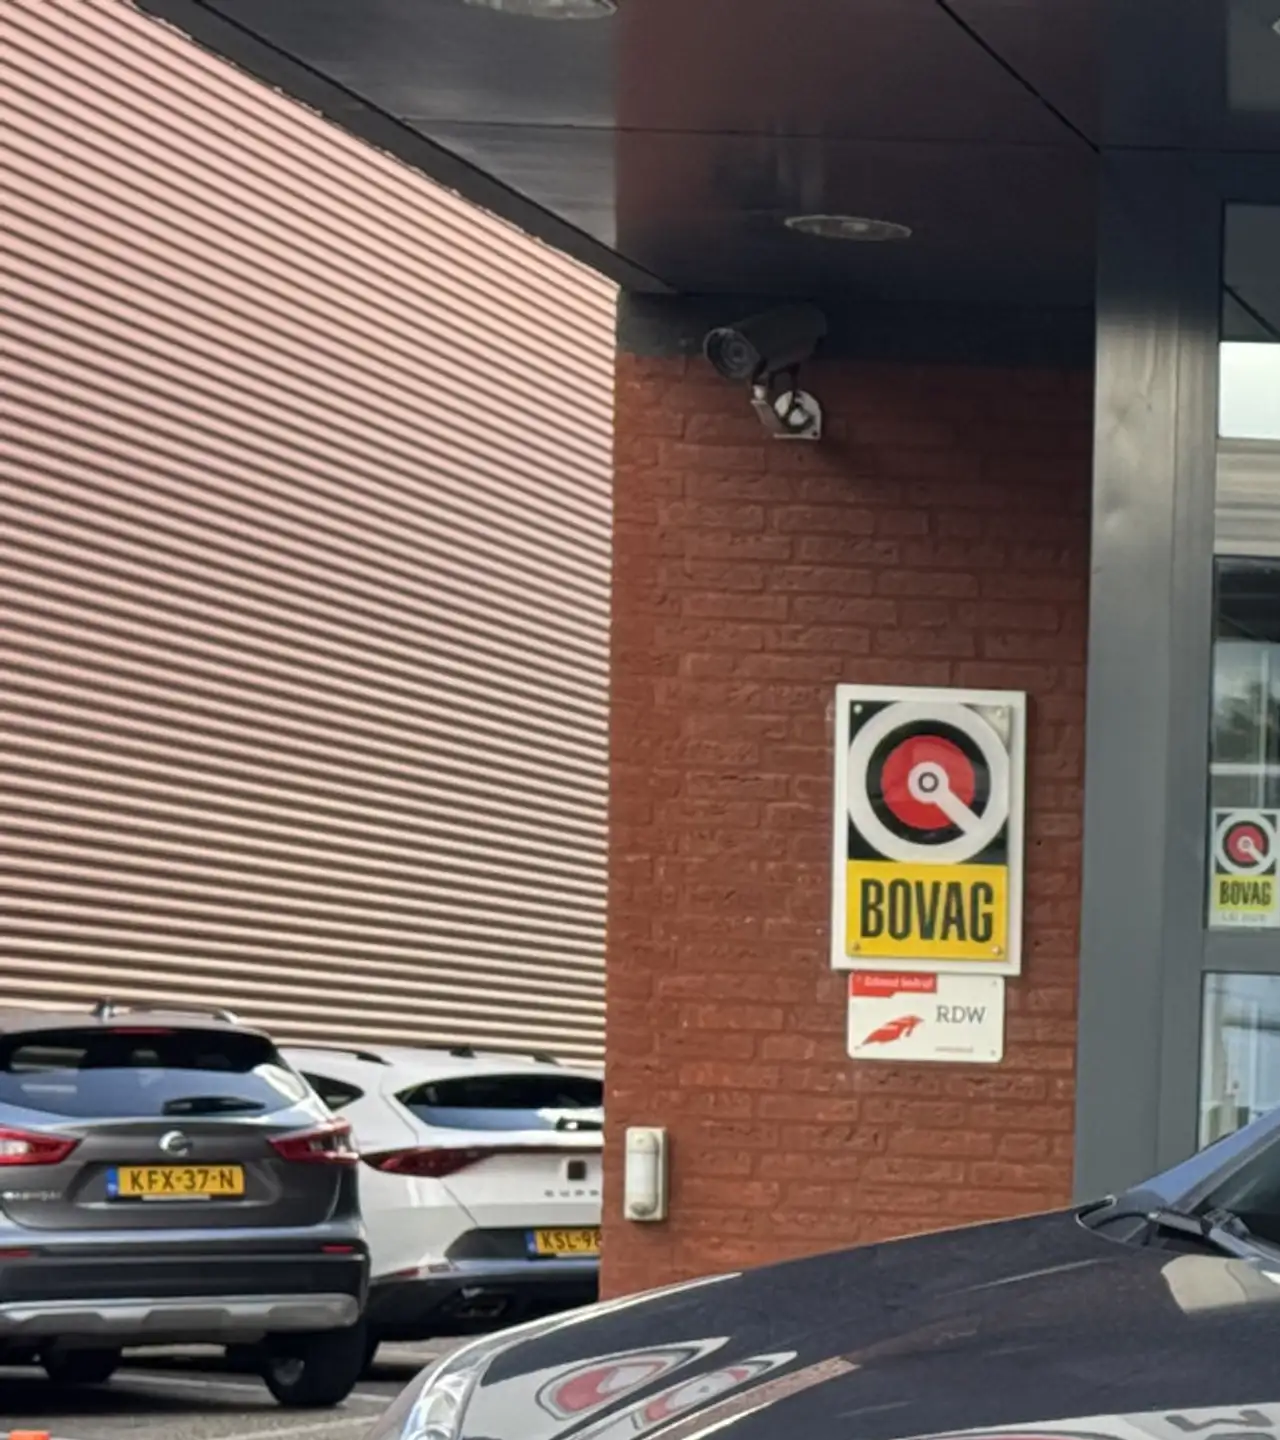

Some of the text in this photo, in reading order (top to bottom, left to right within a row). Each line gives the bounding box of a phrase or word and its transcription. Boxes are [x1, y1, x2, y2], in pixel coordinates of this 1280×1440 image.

[1219, 880, 1272, 906] BOVAG
[860, 877, 995, 943] BOVAG
[935, 1005, 987, 1024] RDW
[129, 1168, 235, 1192] KFX-37-N
